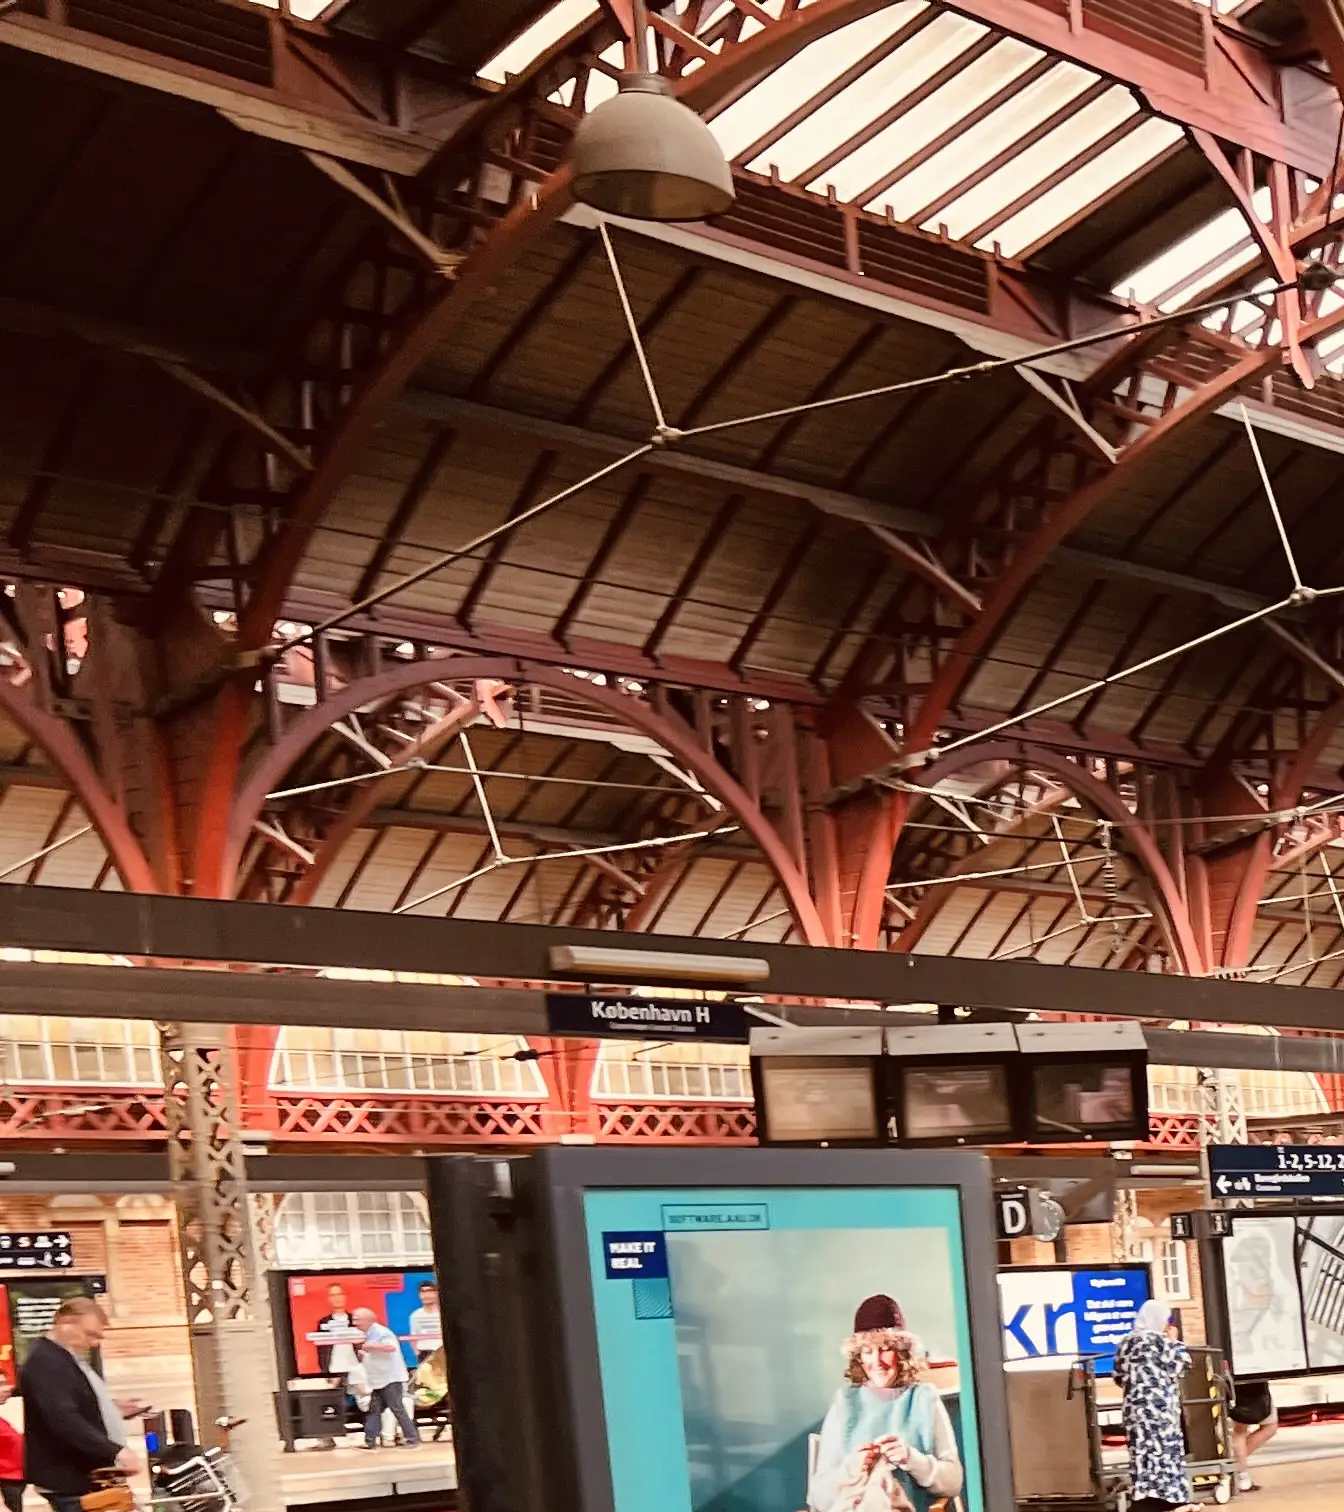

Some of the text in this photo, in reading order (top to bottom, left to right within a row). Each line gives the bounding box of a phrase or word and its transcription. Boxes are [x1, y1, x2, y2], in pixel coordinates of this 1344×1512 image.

[591, 1000, 711, 1023] København H
[1002, 1201, 1027, 1234] D
